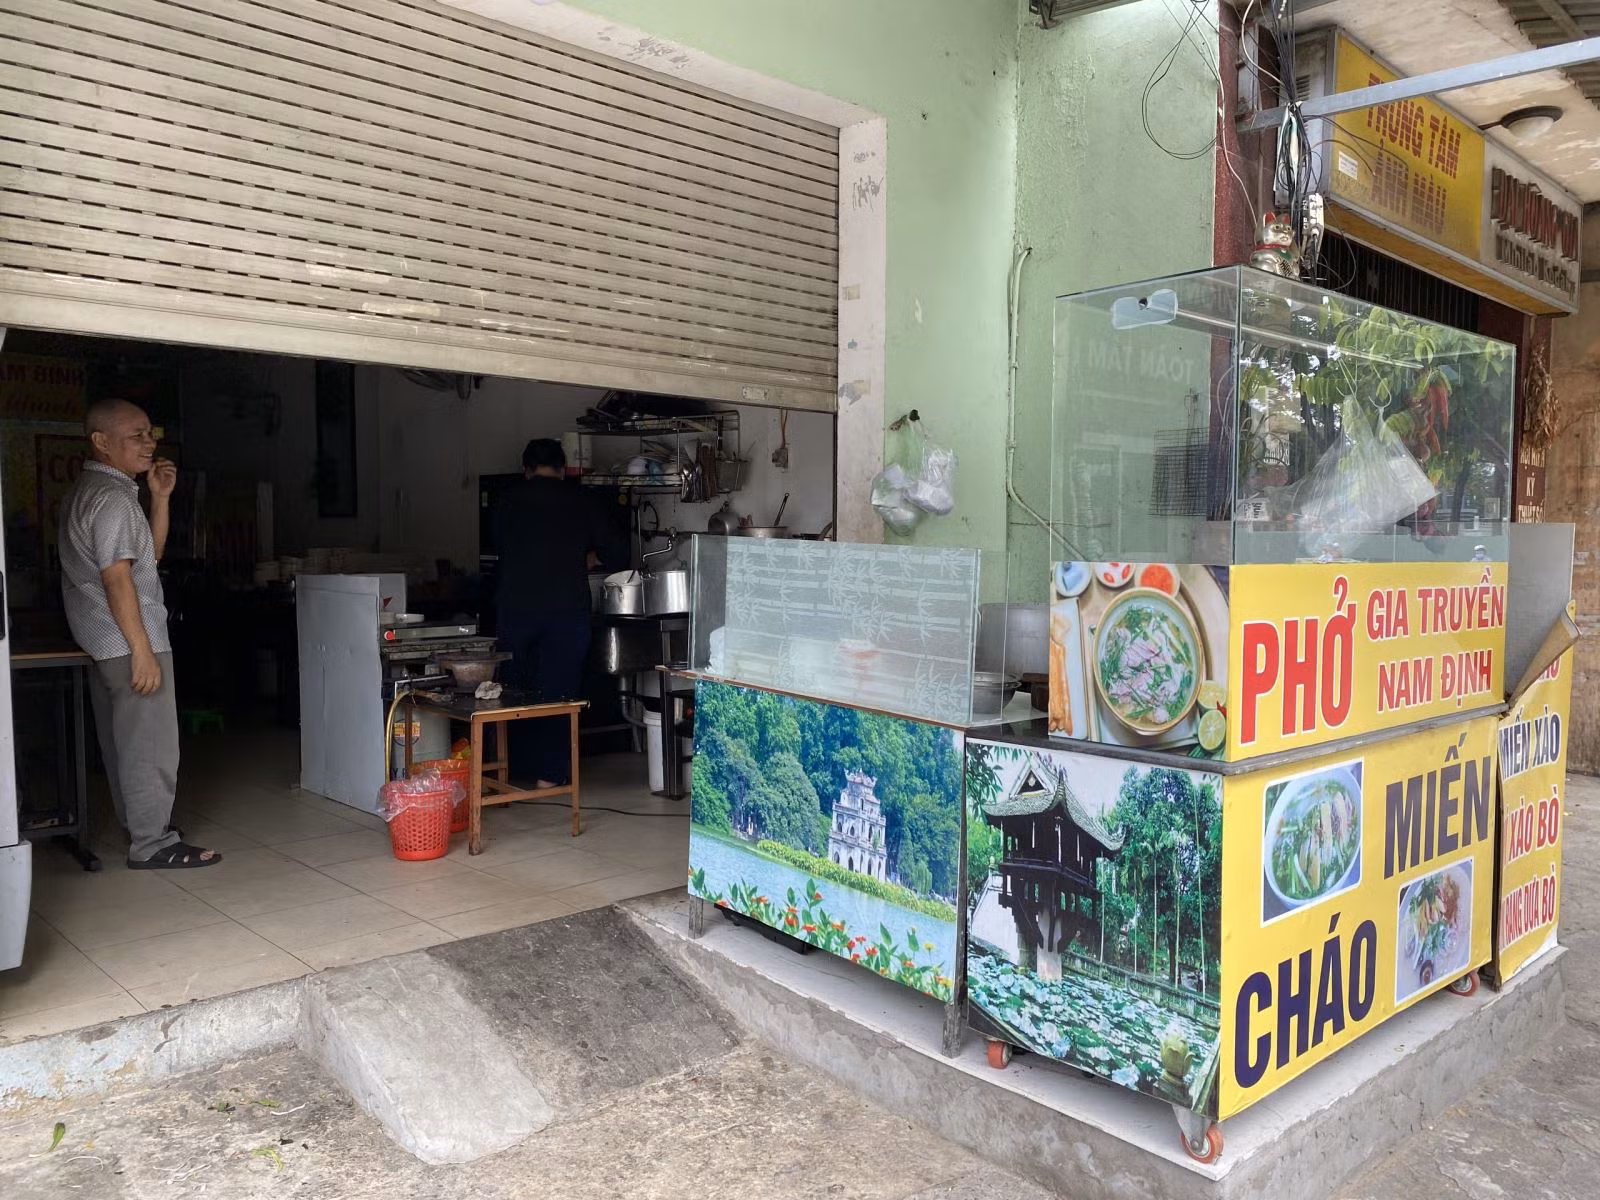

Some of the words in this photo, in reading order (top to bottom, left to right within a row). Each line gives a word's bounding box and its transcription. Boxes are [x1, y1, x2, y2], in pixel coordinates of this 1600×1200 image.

[1367, 72, 1424, 158] TRUNG
[1428, 116, 1461, 180] TÂM
[1366, 588, 1410, 642] GIA
[1416, 567, 1506, 635] TRUYỀN
[1240, 575, 1357, 746] PHỞ
[1377, 655, 1433, 713] NAM
[1439, 648, 1493, 708] ĐỊNH
[1498, 706, 1531, 780] MIẾN
[1532, 705, 1560, 768] XÀO
[1383, 732, 1492, 880] MIẾN
[1508, 797, 1534, 862] XÀO
[1536, 785, 1560, 848] BÒ
[1541, 864, 1556, 924] BÒ
[1233, 912, 1378, 1089] CHÁO
